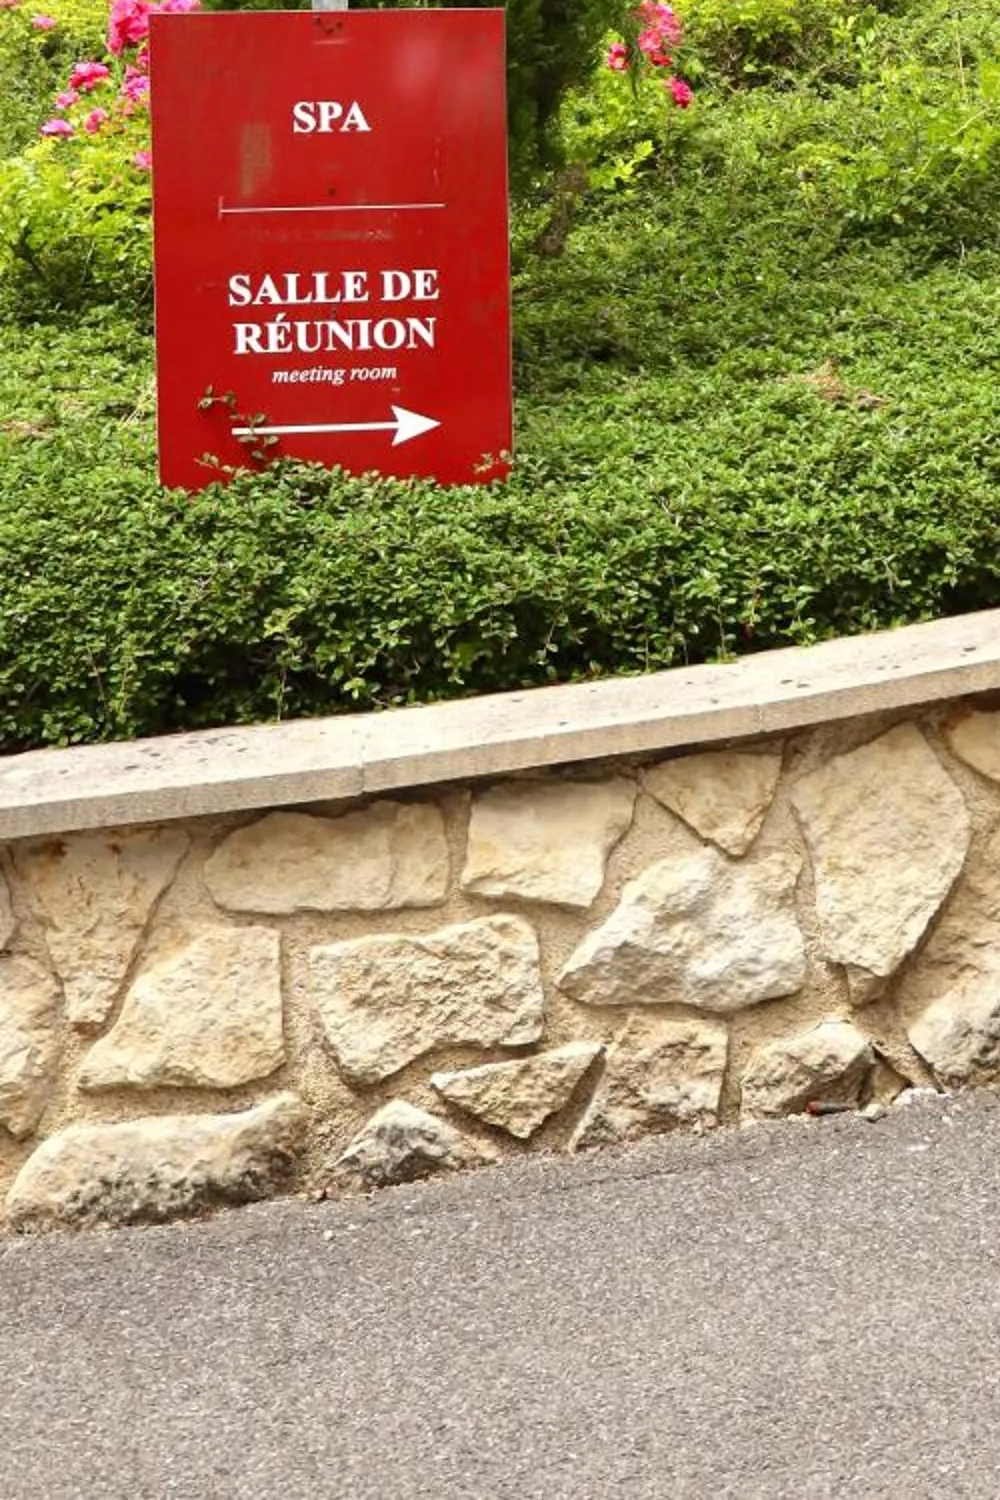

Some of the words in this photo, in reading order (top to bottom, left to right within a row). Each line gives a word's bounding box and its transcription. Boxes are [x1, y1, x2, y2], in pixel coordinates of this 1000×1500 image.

[293, 101, 371, 133] SPA
[229, 271, 369, 306] SALLE
[380, 269, 440, 301] DE
[232, 313, 437, 355] RÉUNION
[271, 365, 346, 385] meeting
[349, 366, 397, 381] room
